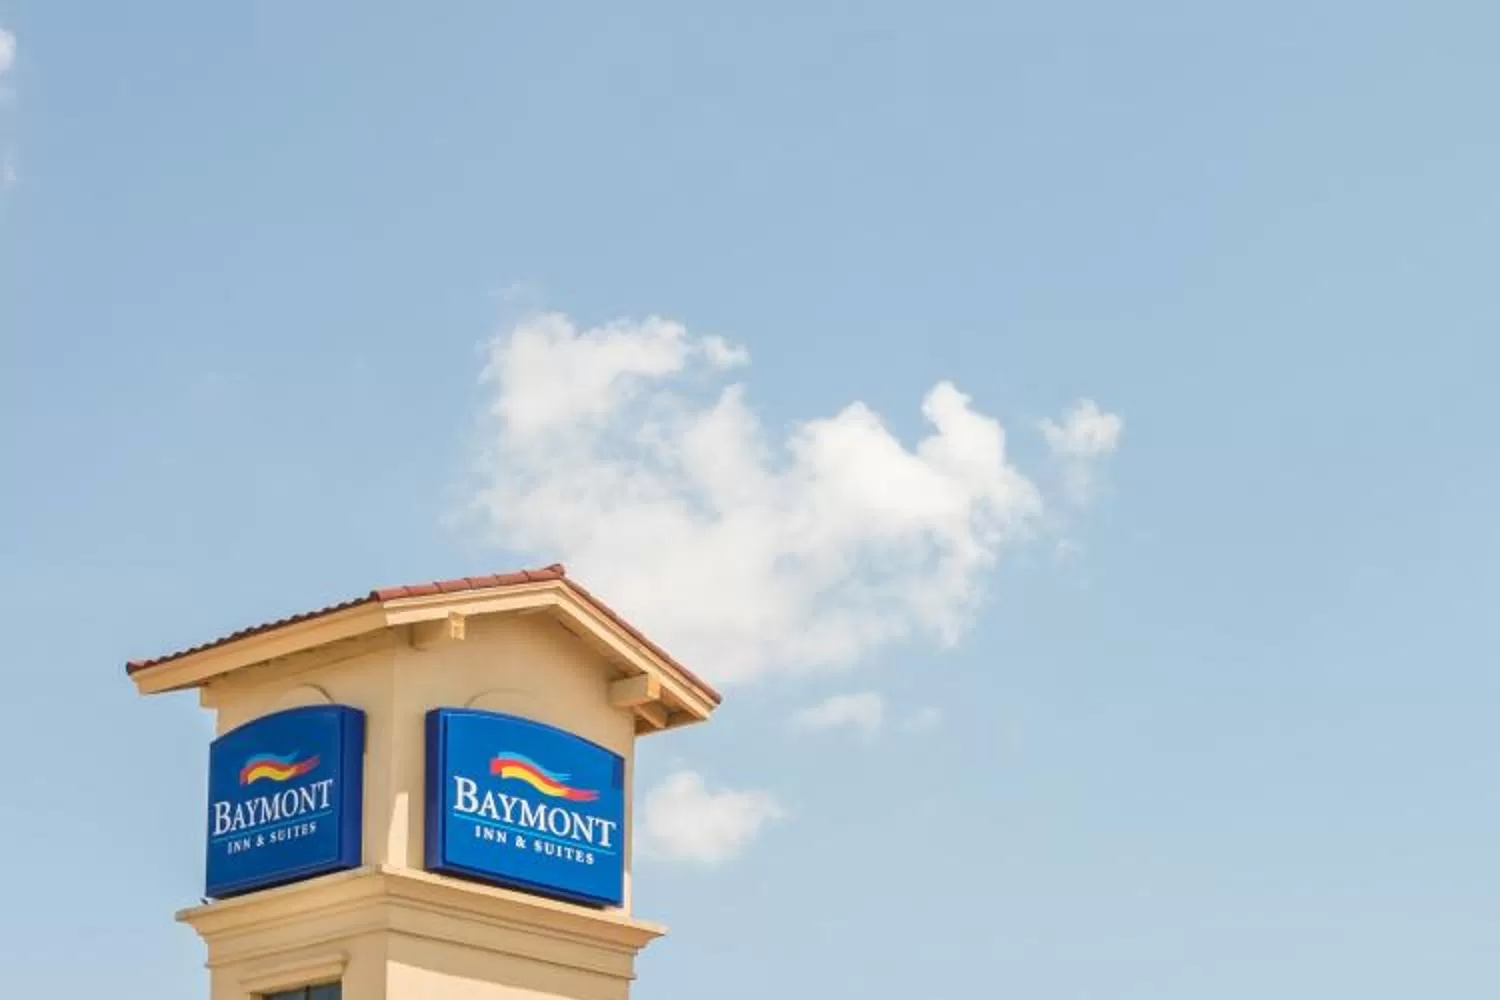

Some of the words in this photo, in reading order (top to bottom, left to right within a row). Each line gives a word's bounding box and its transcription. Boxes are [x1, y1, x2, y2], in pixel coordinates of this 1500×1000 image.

[212, 779, 333, 836] BAYMONT
[453, 775, 617, 848] BAYMONT
[227, 838, 251, 855] INN
[256, 834, 265, 847] &
[269, 822, 317, 843] SUITES
[475, 824, 507, 844] INN
[515, 835, 526, 849] &
[534, 839, 595, 865] SUITES
